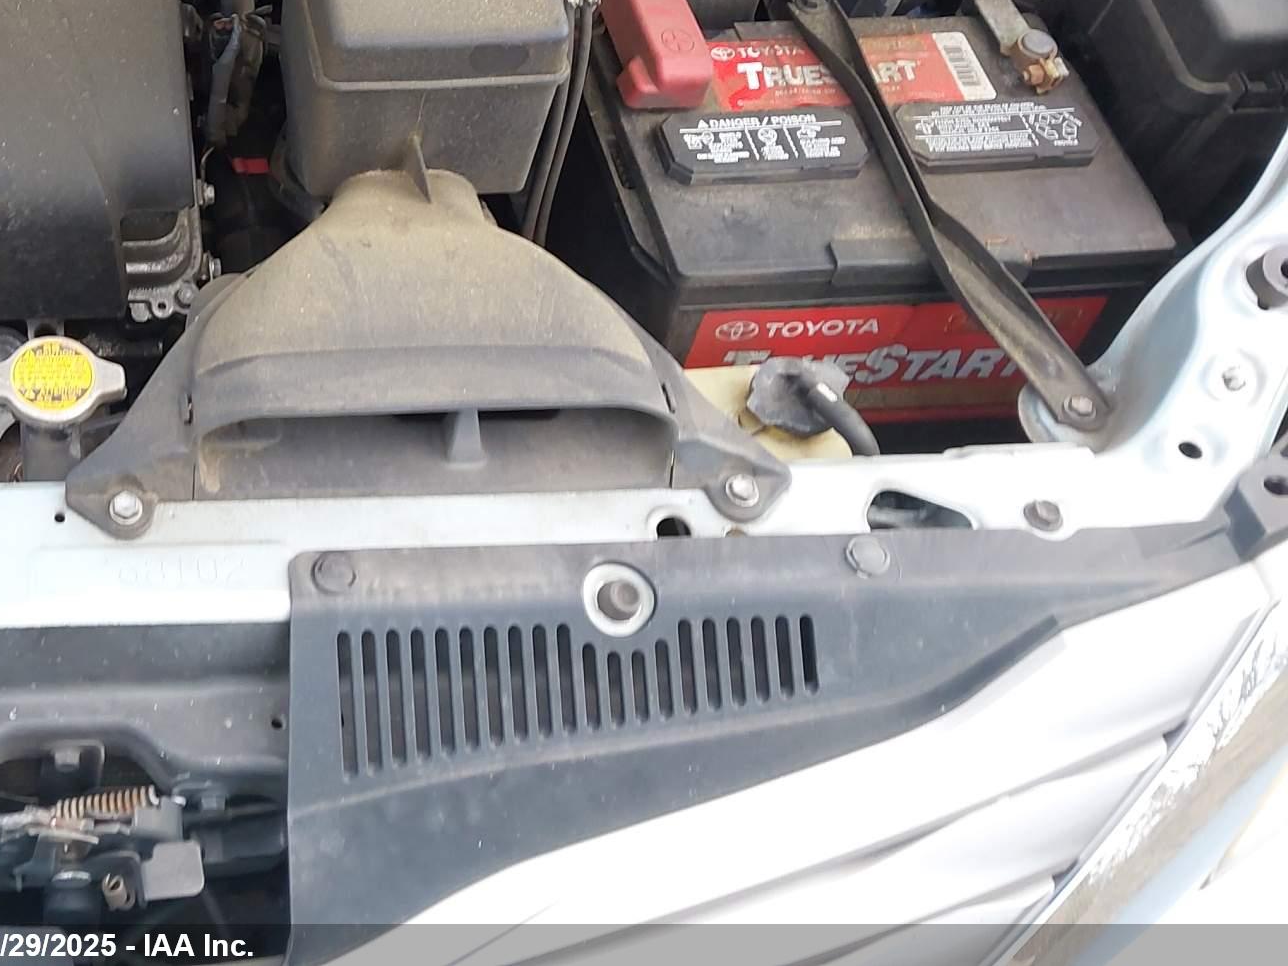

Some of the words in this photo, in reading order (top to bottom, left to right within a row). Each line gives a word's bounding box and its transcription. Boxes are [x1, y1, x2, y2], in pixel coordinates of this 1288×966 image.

[737, 59, 916, 90] TRUESRT
[711, 118, 760, 129] DANGER
[771, 114, 816, 126] POISON
[766, 318, 879, 339] TOYOTA
[723, 344, 1018, 384] TESTAR
